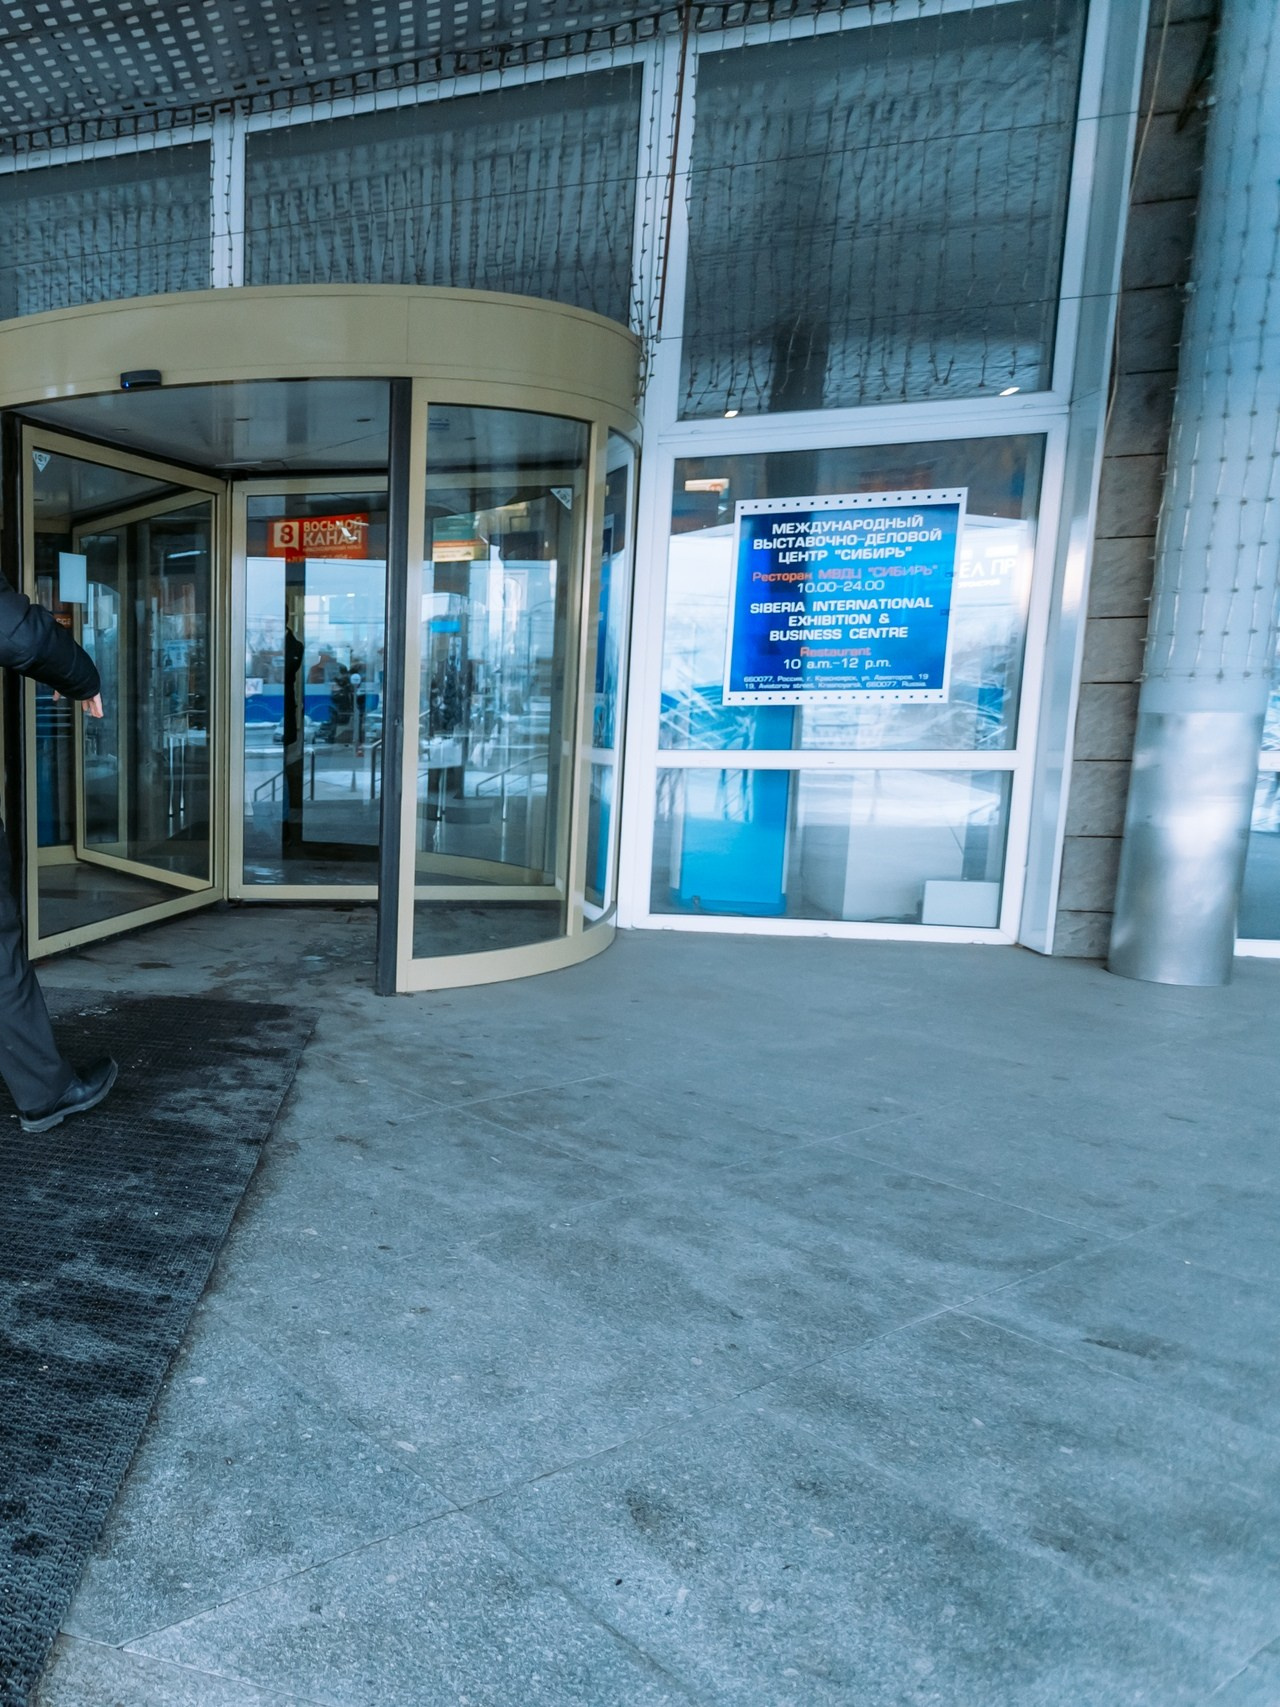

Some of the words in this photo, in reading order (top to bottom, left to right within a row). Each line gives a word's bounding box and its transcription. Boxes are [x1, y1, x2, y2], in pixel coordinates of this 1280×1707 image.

[772, 514, 924, 535] МЕЖДУНАРОДНЫЙ
[303, 529, 362, 547] КАНАЛ
[753, 528, 942, 550] ВЫСТАВОЧНО-ДЕЛОВОЙ
[778, 550, 829, 565] ЦЕНТР
[834, 545, 912, 561] "СИБИРЬ"
[752, 571, 813, 583] Ресторан
[818, 567, 862, 580] МВДЦ
[868, 564, 938, 578] "СИБИРЬ"
[797, 579, 885, 594] 10.00-24.00
[750, 601, 805, 614] SIBERIA
[812, 597, 934, 612] INTERNATIONAL
[788, 613, 871, 627] EXHIBITION
[878, 612, 890, 624] &
[769, 628, 842, 641] BUSINESS
[849, 626, 909, 639] CENTRE
[783, 658, 802, 669] 10
[865, 659, 892, 670] p.m.
